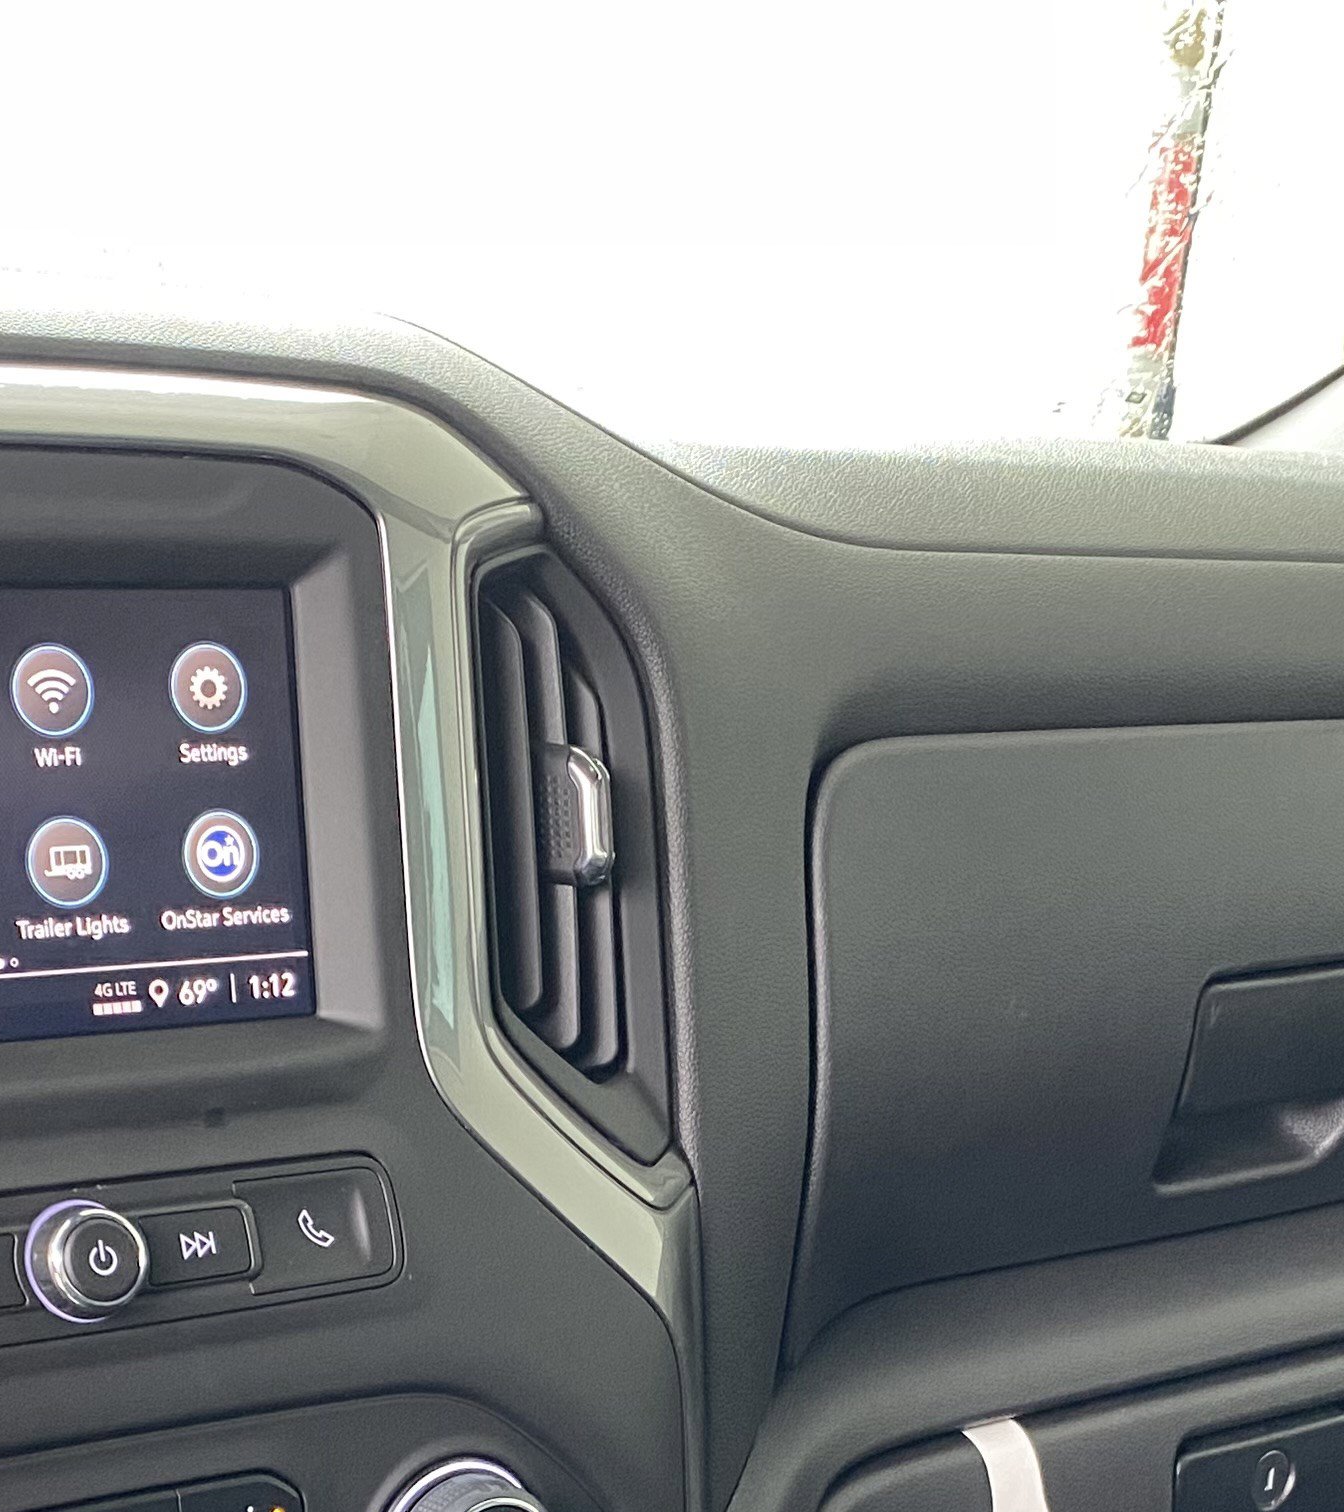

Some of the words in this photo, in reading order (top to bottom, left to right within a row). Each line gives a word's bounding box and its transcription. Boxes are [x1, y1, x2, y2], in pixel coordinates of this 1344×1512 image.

[33, 747, 82, 768] Wi-Fi
[179, 743, 249, 767] Settings
[16, 917, 73, 940] Trailer
[75, 914, 131, 941] Lights
[160, 910, 220, 931] OnStar
[222, 905, 290, 928] Services
[93, 982, 114, 998] 4G
[115, 980, 137, 996] LTE
[248, 971, 297, 999] 1:12
